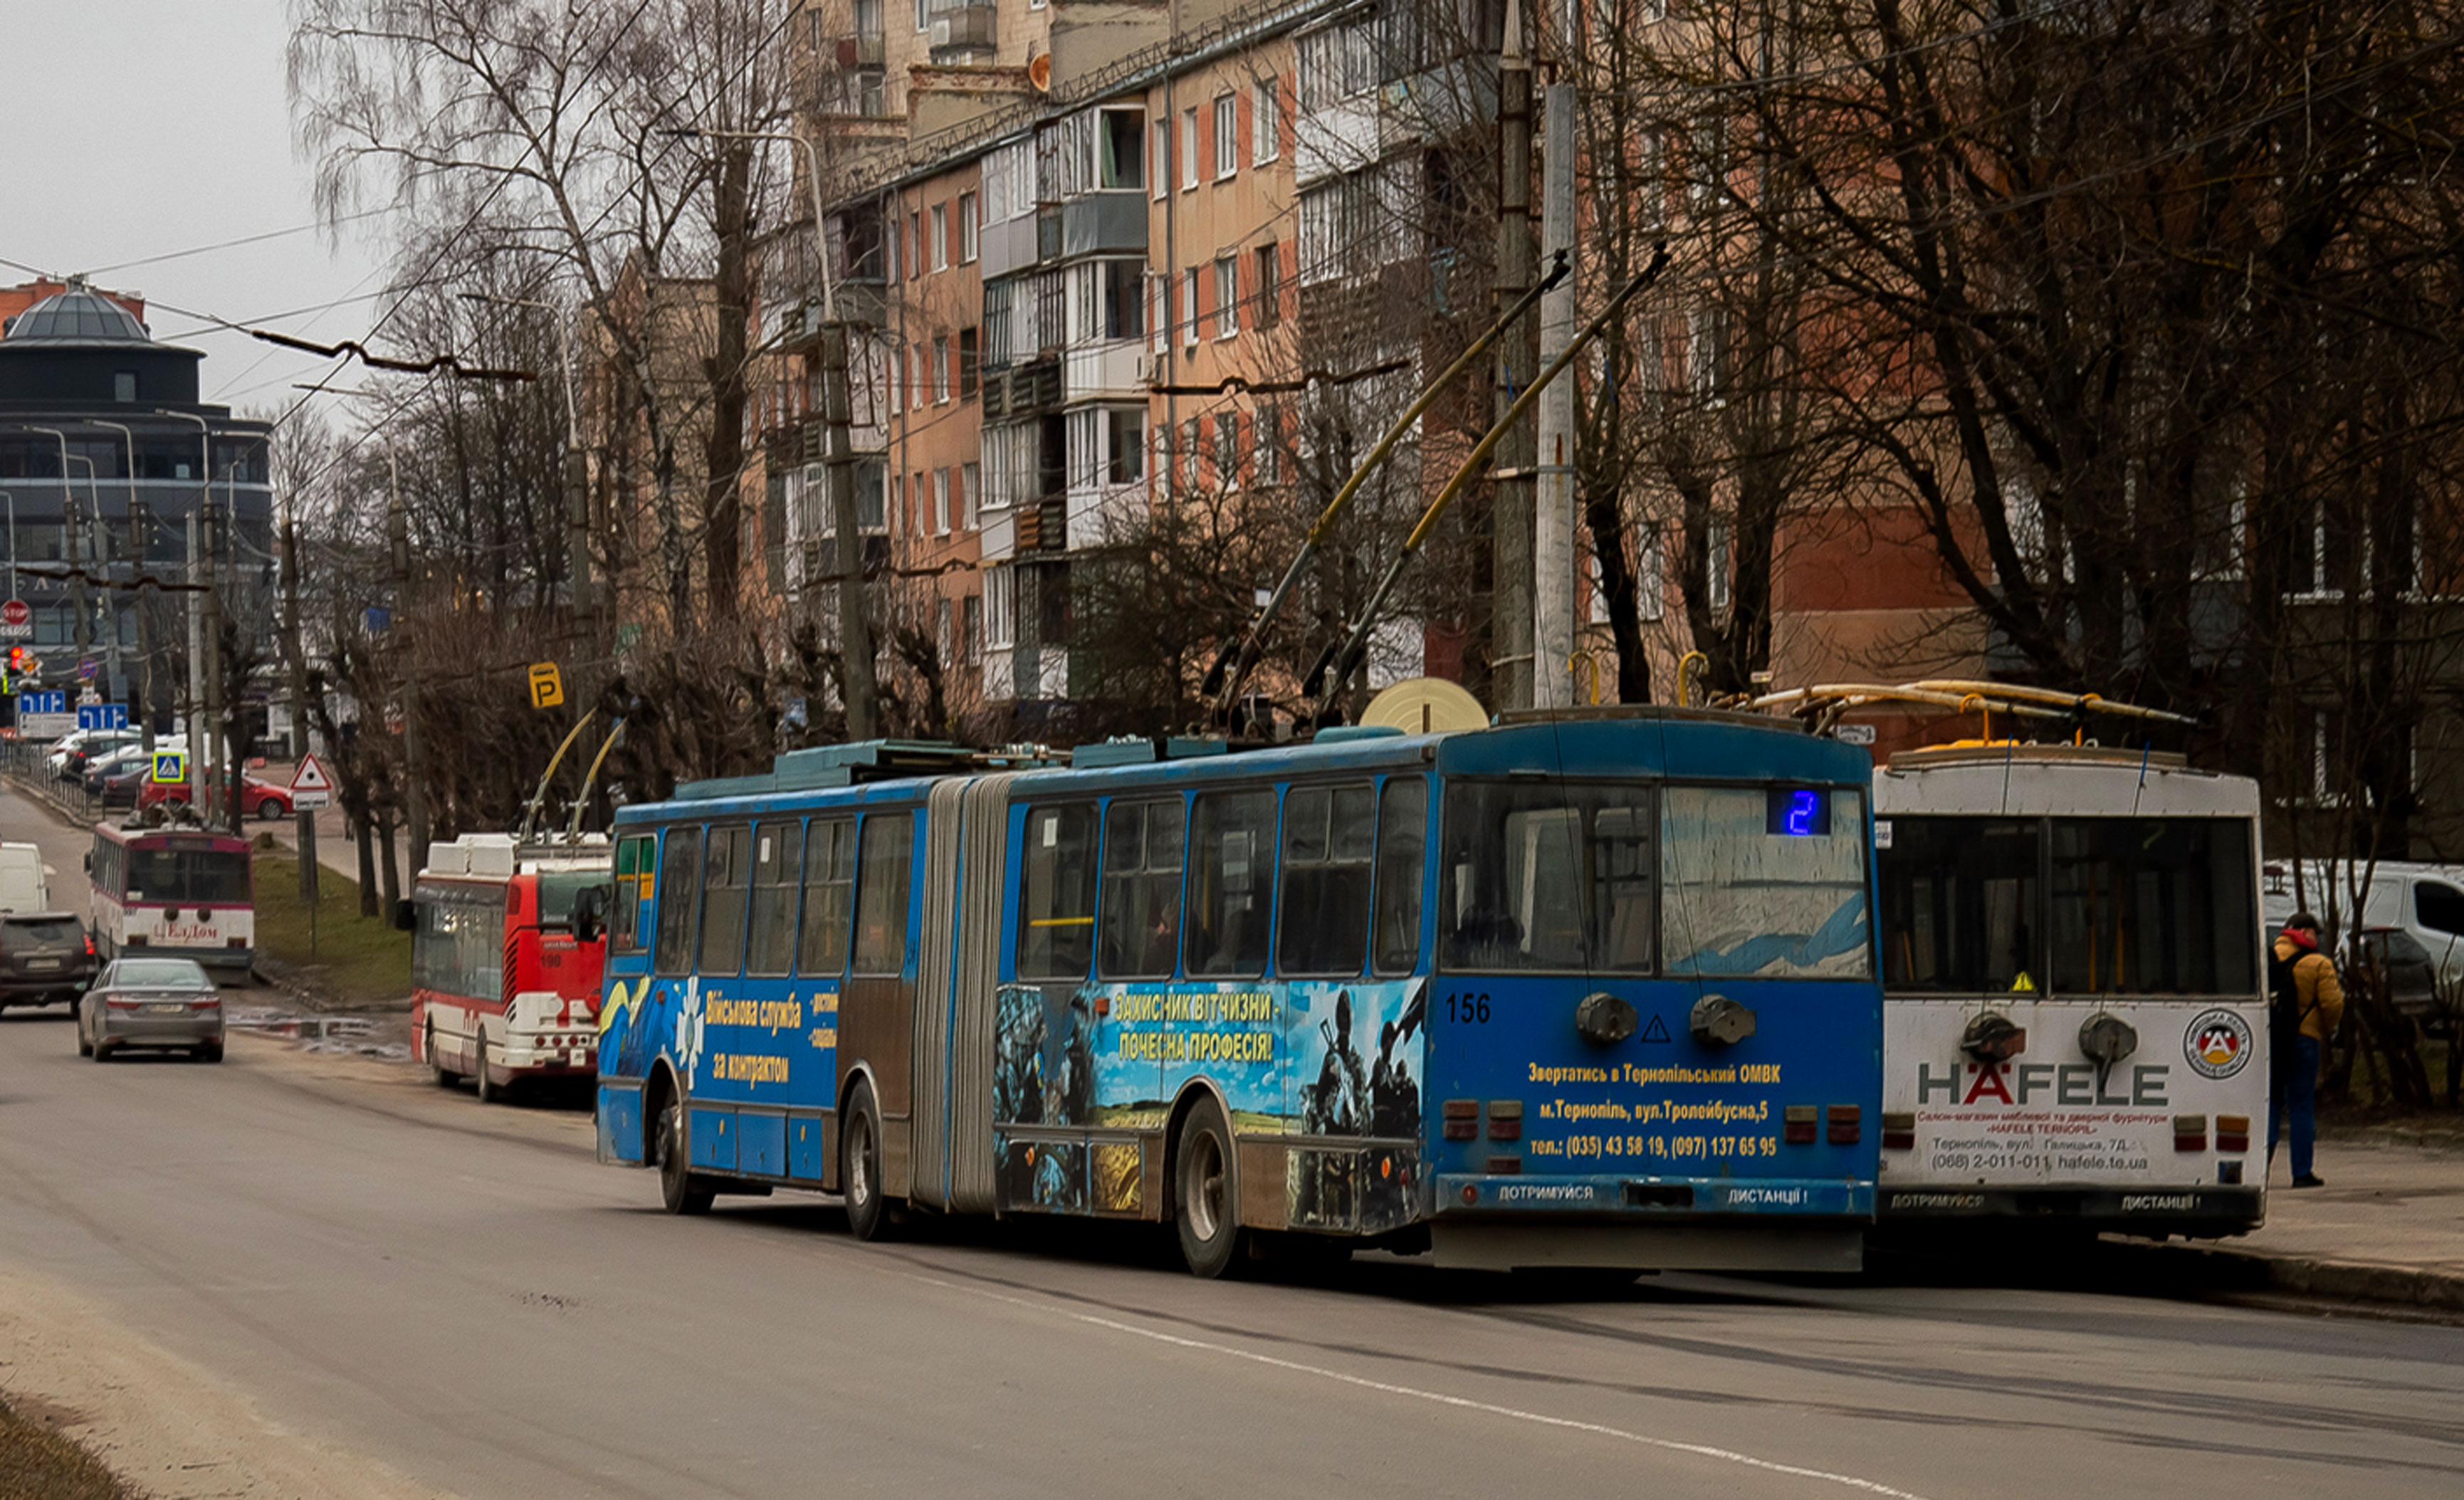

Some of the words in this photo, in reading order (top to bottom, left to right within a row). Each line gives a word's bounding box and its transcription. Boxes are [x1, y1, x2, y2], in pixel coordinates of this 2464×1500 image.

[536, 680, 555, 706] P
[1788, 790, 1815, 836] 2
[706, 990, 758, 1027] Військова
[759, 992, 801, 1038] служба
[1115, 993, 1191, 1022] ЗАХИСНИК
[1193, 993, 1272, 1022] ВІТЧИЗНИ
[1446, 993, 1490, 1024] 156
[1118, 1032, 1185, 1060] ПОЧЕСНА
[1188, 1032, 1273, 1061] ПРОФЕСІЯ!
[713, 1052, 727, 1079] за
[728, 1054, 789, 1091] контрактом
[1529, 1062, 1608, 1086] Звертатись
[1610, 1067, 1620, 1083] в
[1623, 1063, 1736, 1087] Тернопільський
[1739, 1064, 1781, 1084] ОМВК
[1918, 1063, 2170, 1106] HÄFELE
[1540, 1098, 1632, 1123] м.Тернопіль,
[1635, 1099, 1768, 1125] вул.Тролейбусна,5
[1531, 1140, 1563, 1155] тел.:
[1566, 1136, 1601, 1160] (035)
[1605, 1136, 1623, 1155] 43
[1626, 1136, 1643, 1156] 58
[1647, 1136, 1668, 1160] 19,
[1671, 1136, 1707, 1160] (097)
[1711, 1137, 1736, 1156] 137
[1739, 1137, 1756, 1156] 65
[1758, 1137, 1776, 1157] 95
[1932, 1138, 2003, 1151] Тернопіль,
[2006, 1140, 2033, 1152] вул.
[1931, 1154, 1970, 1171] (068)
[1498, 1183, 1594, 1202] ДОТРИМУЙСЯ
[1891, 1193, 1984, 1209] ДОТРИМУЙСЯ
